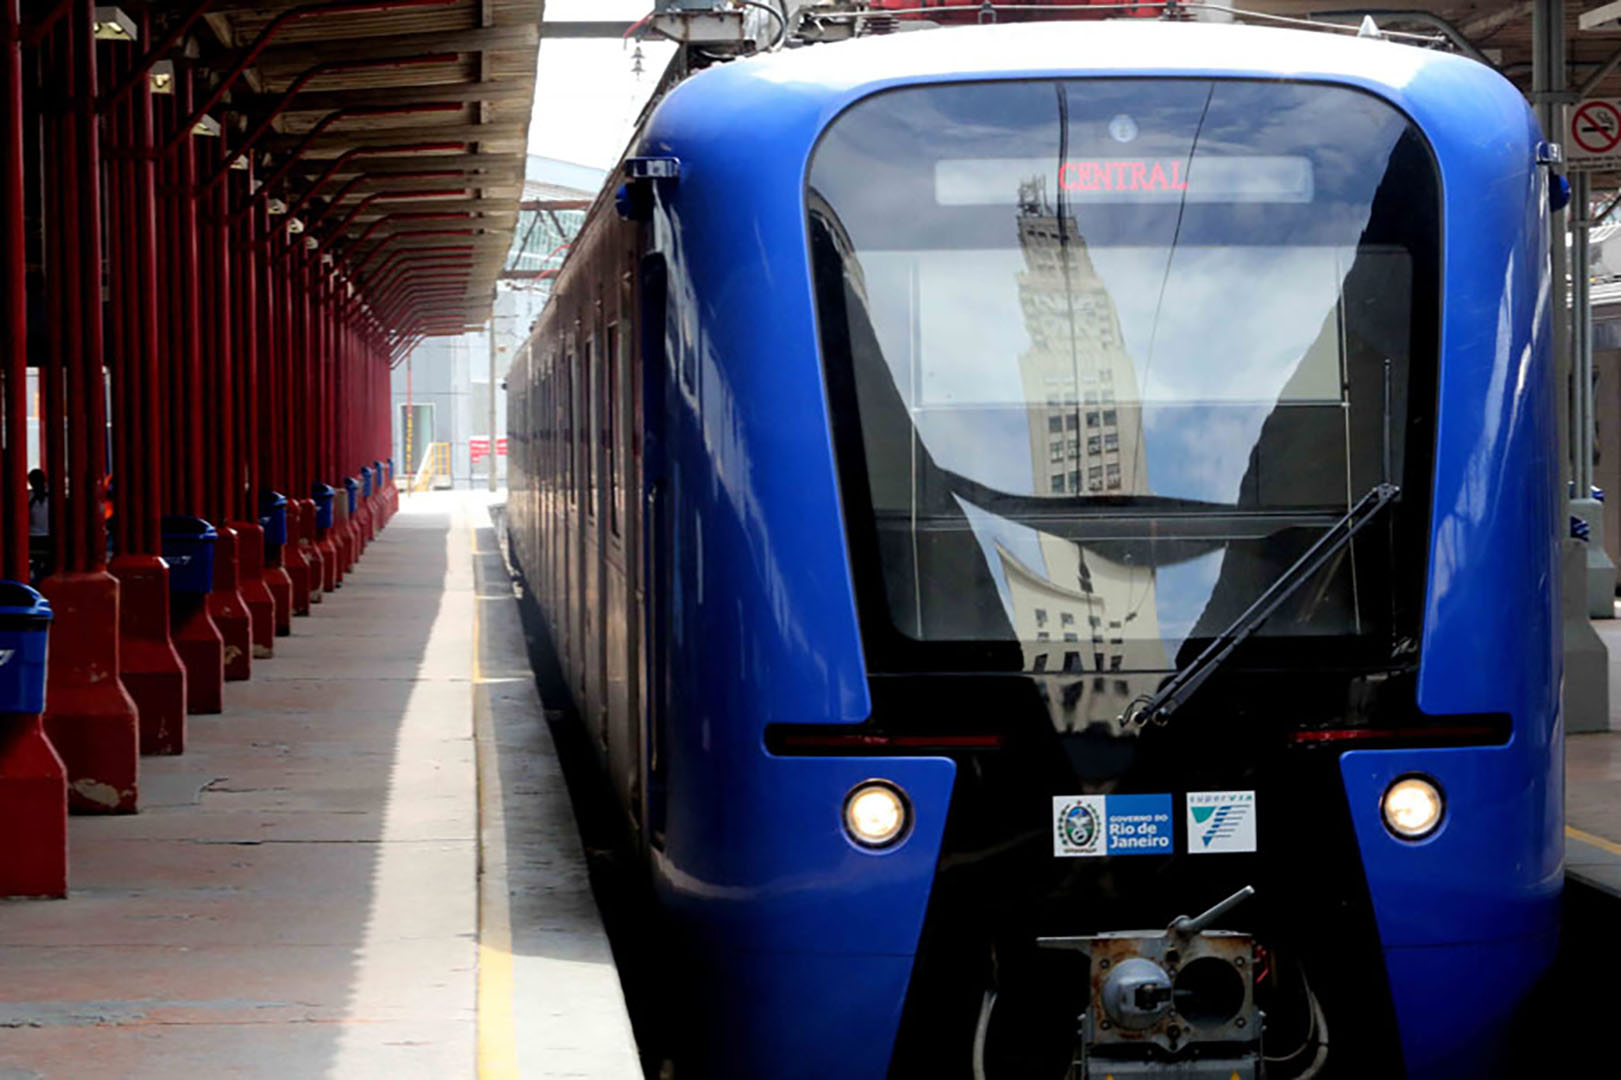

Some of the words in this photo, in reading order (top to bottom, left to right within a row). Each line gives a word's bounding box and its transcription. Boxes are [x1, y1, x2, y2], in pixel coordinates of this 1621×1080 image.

[1058, 161, 1187, 190] CENTRAL
[1154, 814, 1168, 822] DO
[1109, 823, 1135, 835] Rio
[1137, 822, 1157, 835] de
[1110, 835, 1169, 848] Janeiro
